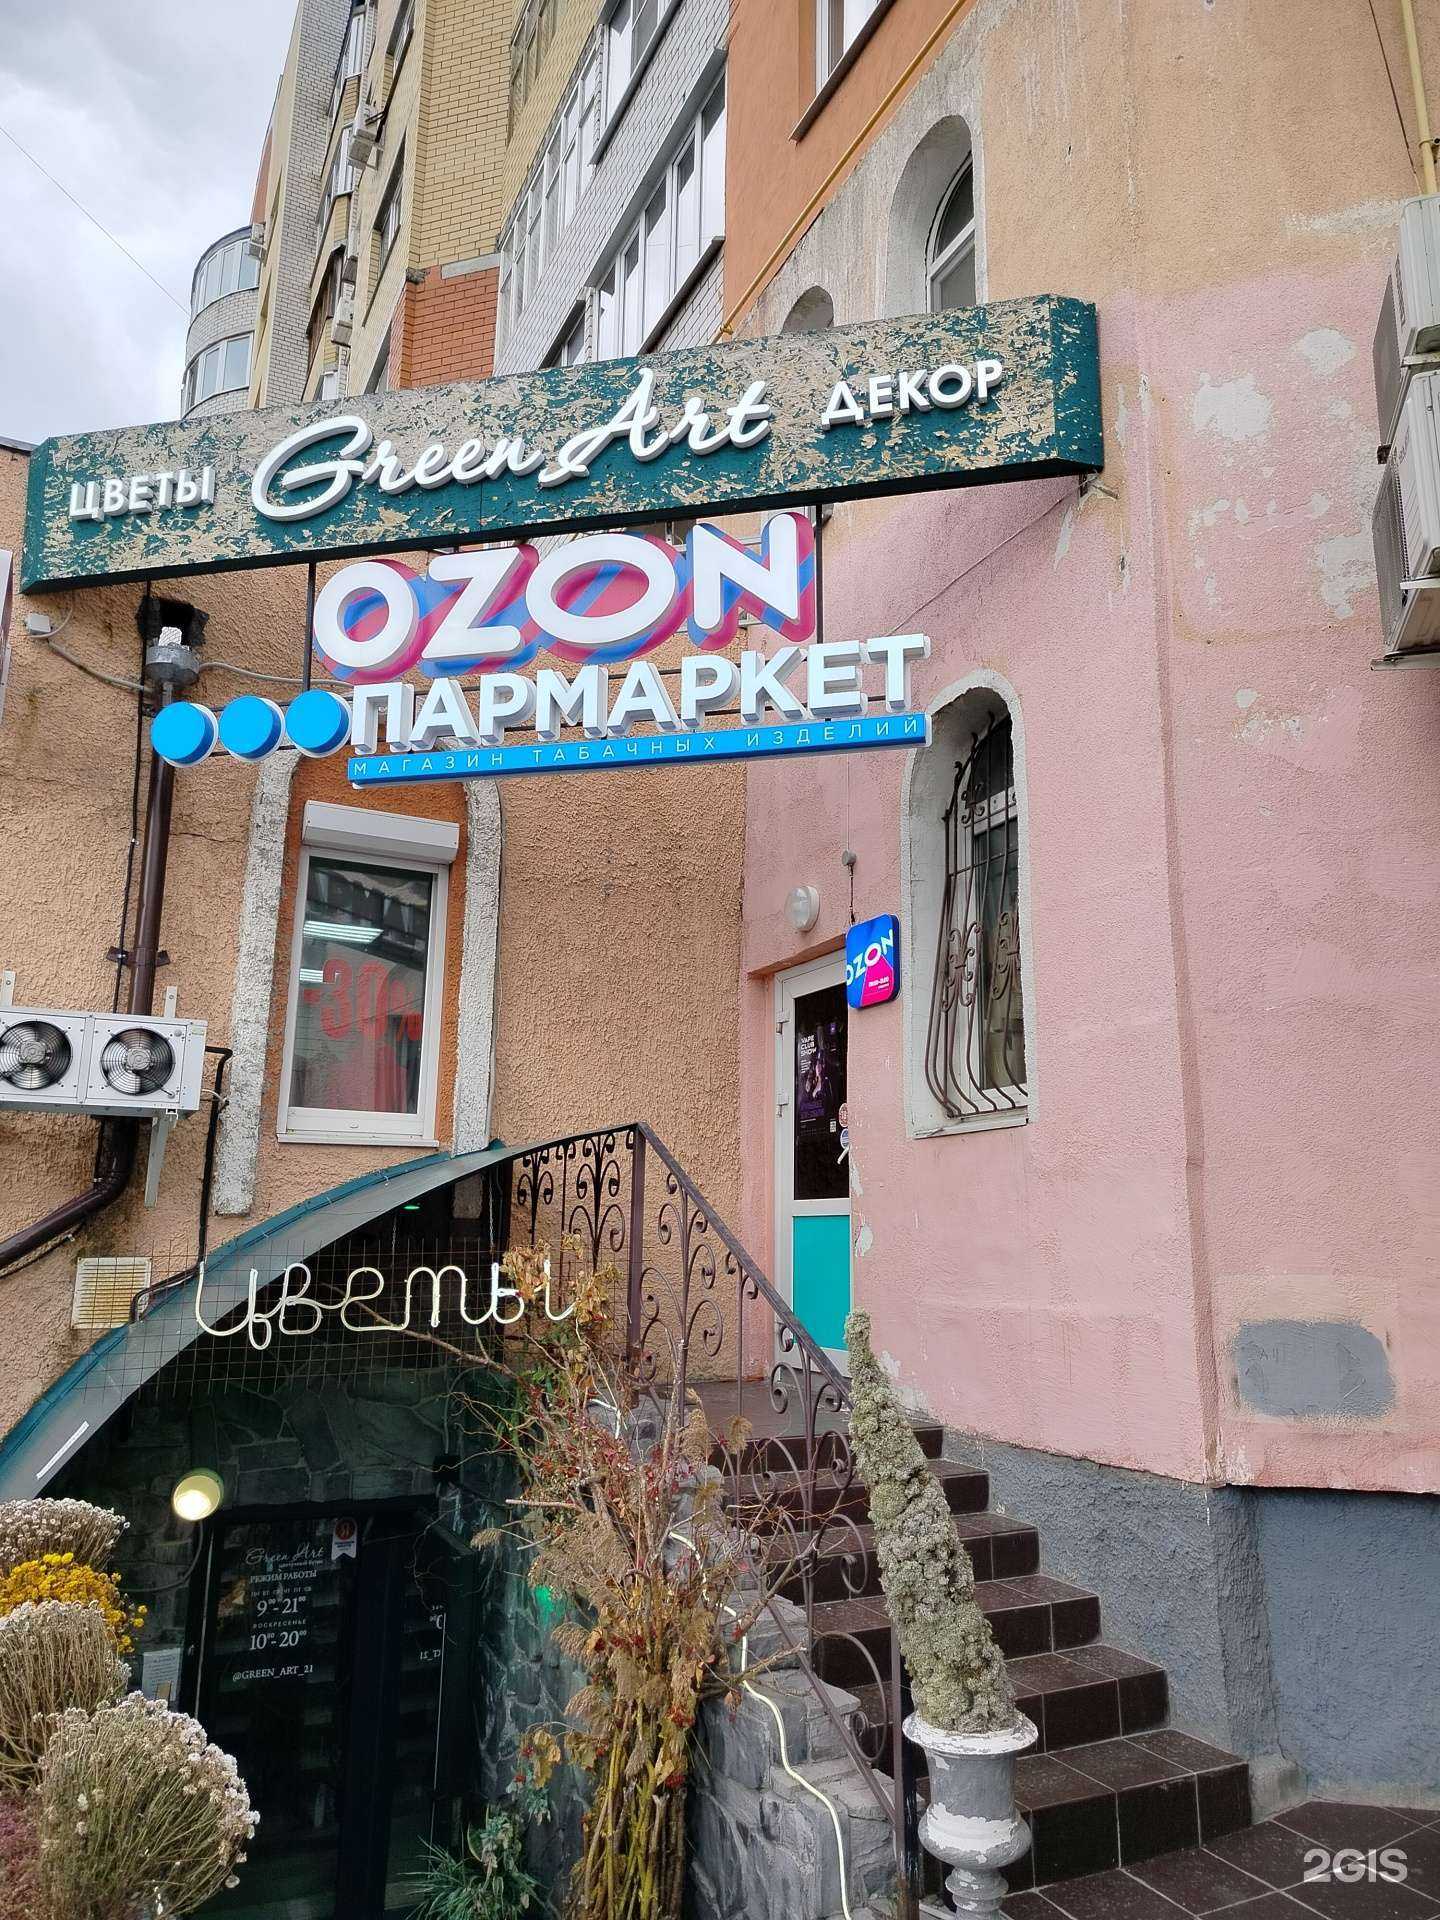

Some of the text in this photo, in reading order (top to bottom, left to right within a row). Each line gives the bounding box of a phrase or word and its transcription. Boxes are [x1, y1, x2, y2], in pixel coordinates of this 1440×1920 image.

[820, 359, 1003, 431] ДЕКОР
[251, 367, 771, 521] Green Art
[68, 467, 215, 522] ЦВЕТЫ
[314, 512, 814, 682] OZON
[350, 633, 930, 754] ПАРМАРКЕТ
[353, 715, 918, 777] МАГАЗИН ТАБАЧНЫХ ИЗДЕЛИЙ
[846, 928, 894, 986] OZON
